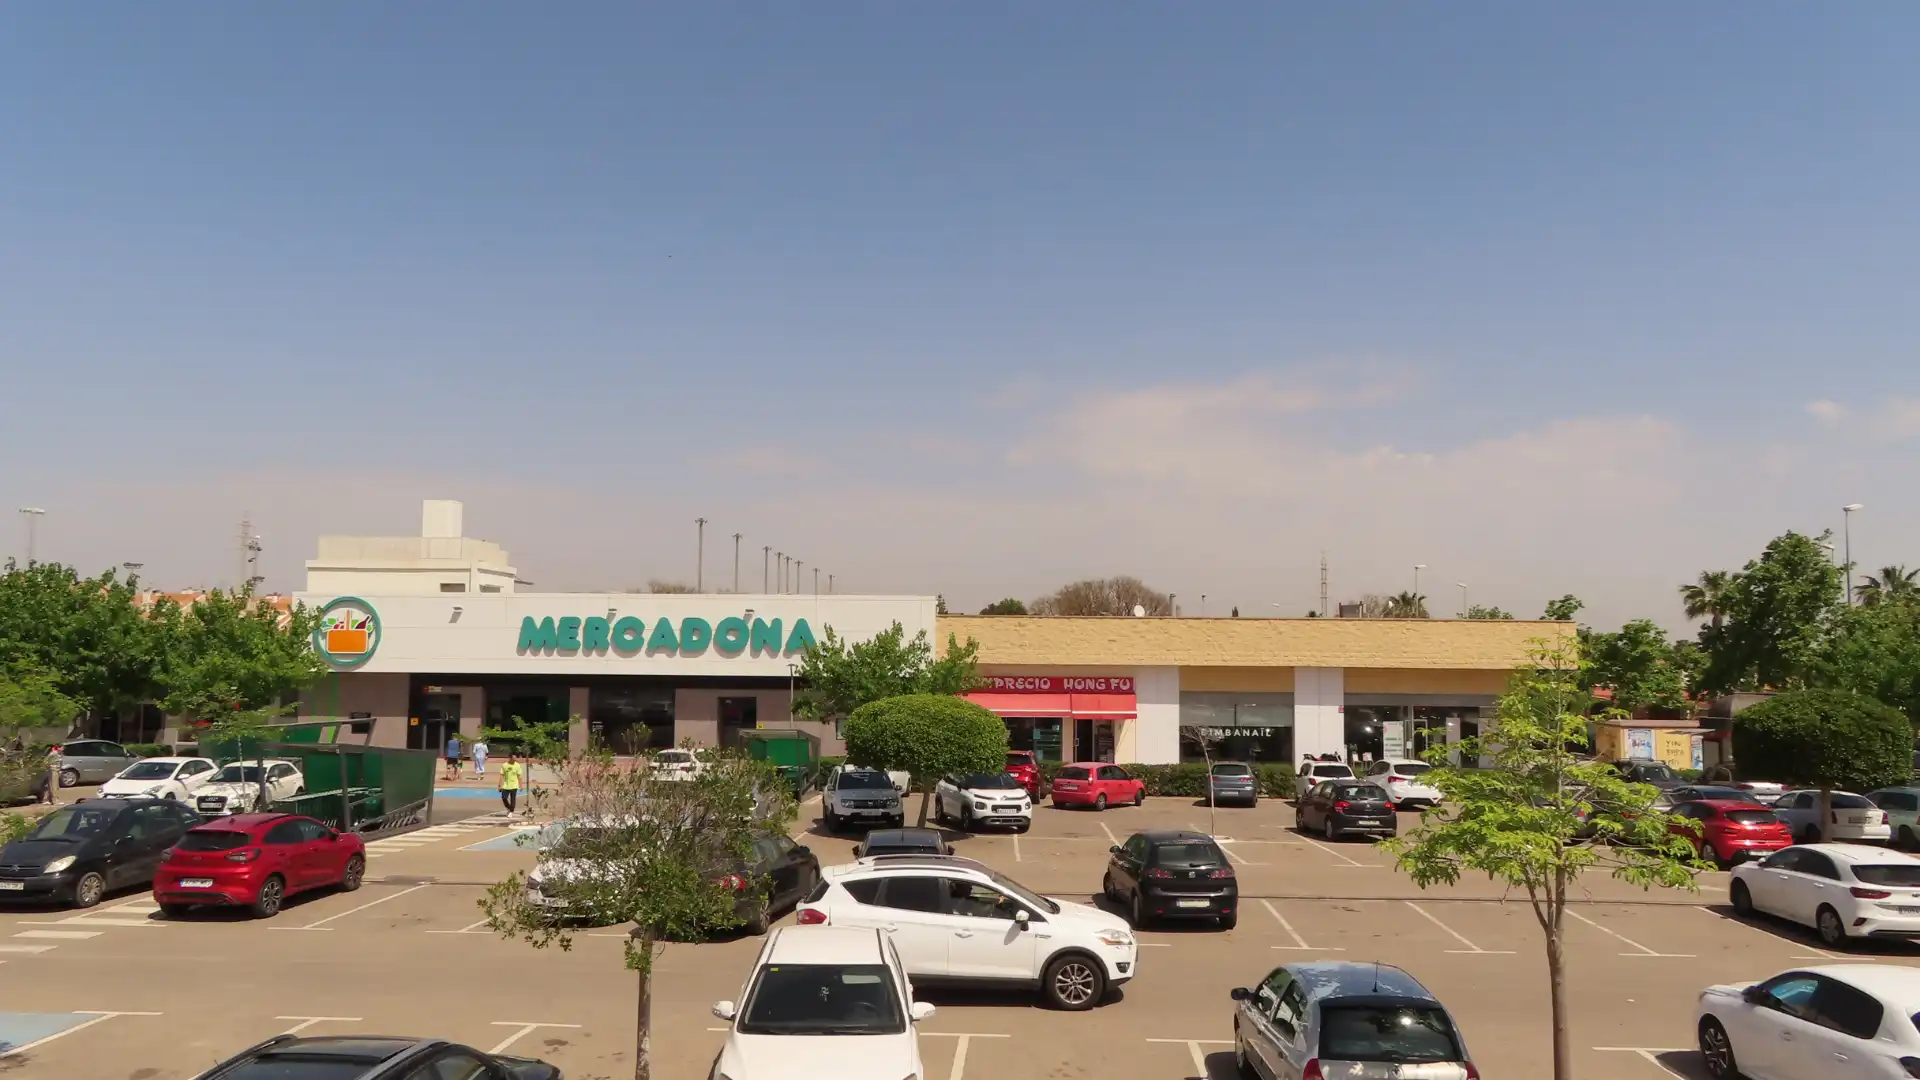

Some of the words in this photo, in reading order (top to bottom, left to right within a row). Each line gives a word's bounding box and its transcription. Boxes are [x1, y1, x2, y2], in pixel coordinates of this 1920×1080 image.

[518, 616, 819, 653] MERCADONA
[1064, 678, 1107, 690] HONG
[1110, 678, 1131, 690] FU
